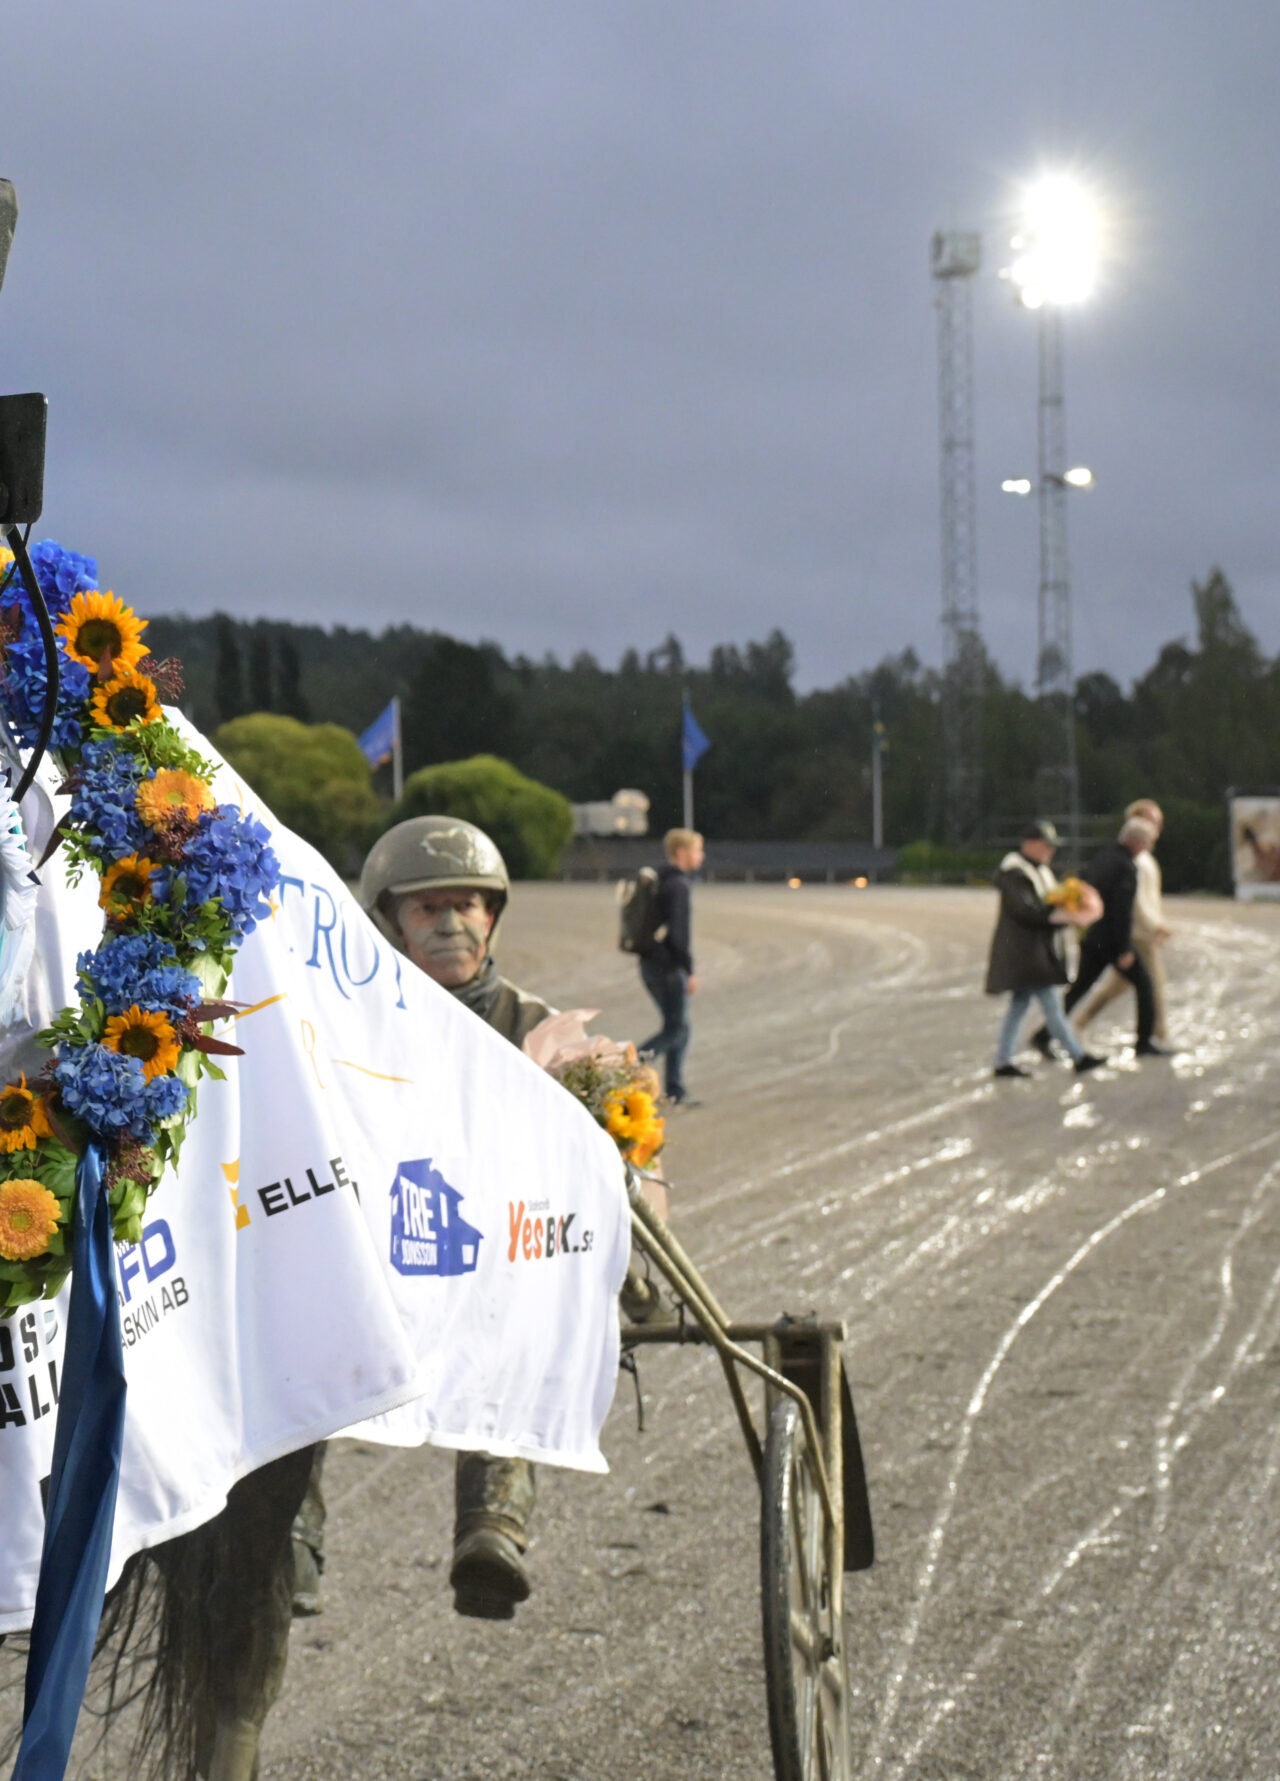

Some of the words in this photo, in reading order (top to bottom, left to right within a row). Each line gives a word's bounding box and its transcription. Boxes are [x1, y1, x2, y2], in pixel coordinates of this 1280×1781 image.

[257, 1156, 360, 1217] ELLE
[400, 1175, 437, 1240] TRE
[141, 1276, 189, 1317] AB
